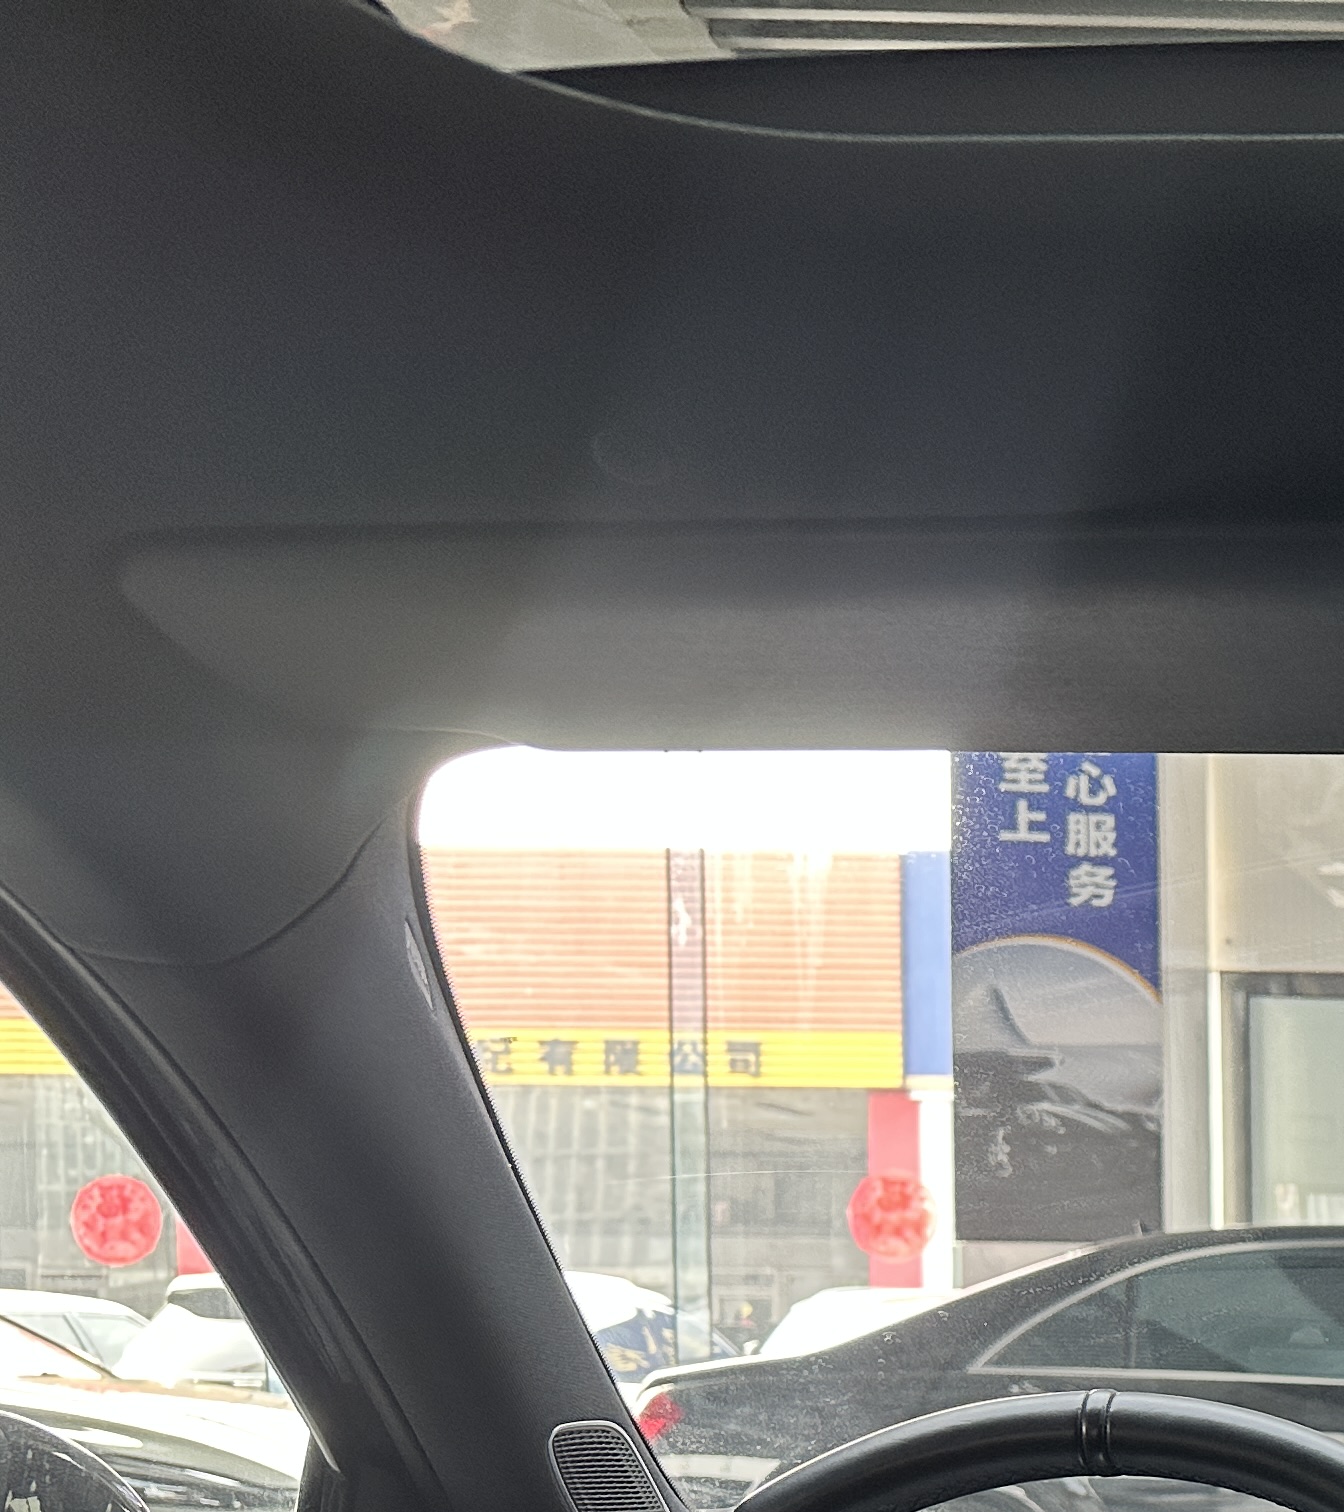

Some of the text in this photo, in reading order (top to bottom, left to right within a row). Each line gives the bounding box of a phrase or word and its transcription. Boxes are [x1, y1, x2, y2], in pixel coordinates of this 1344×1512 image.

[998, 753, 1051, 842] 至上
[1064, 761, 1118, 908] 心服务
